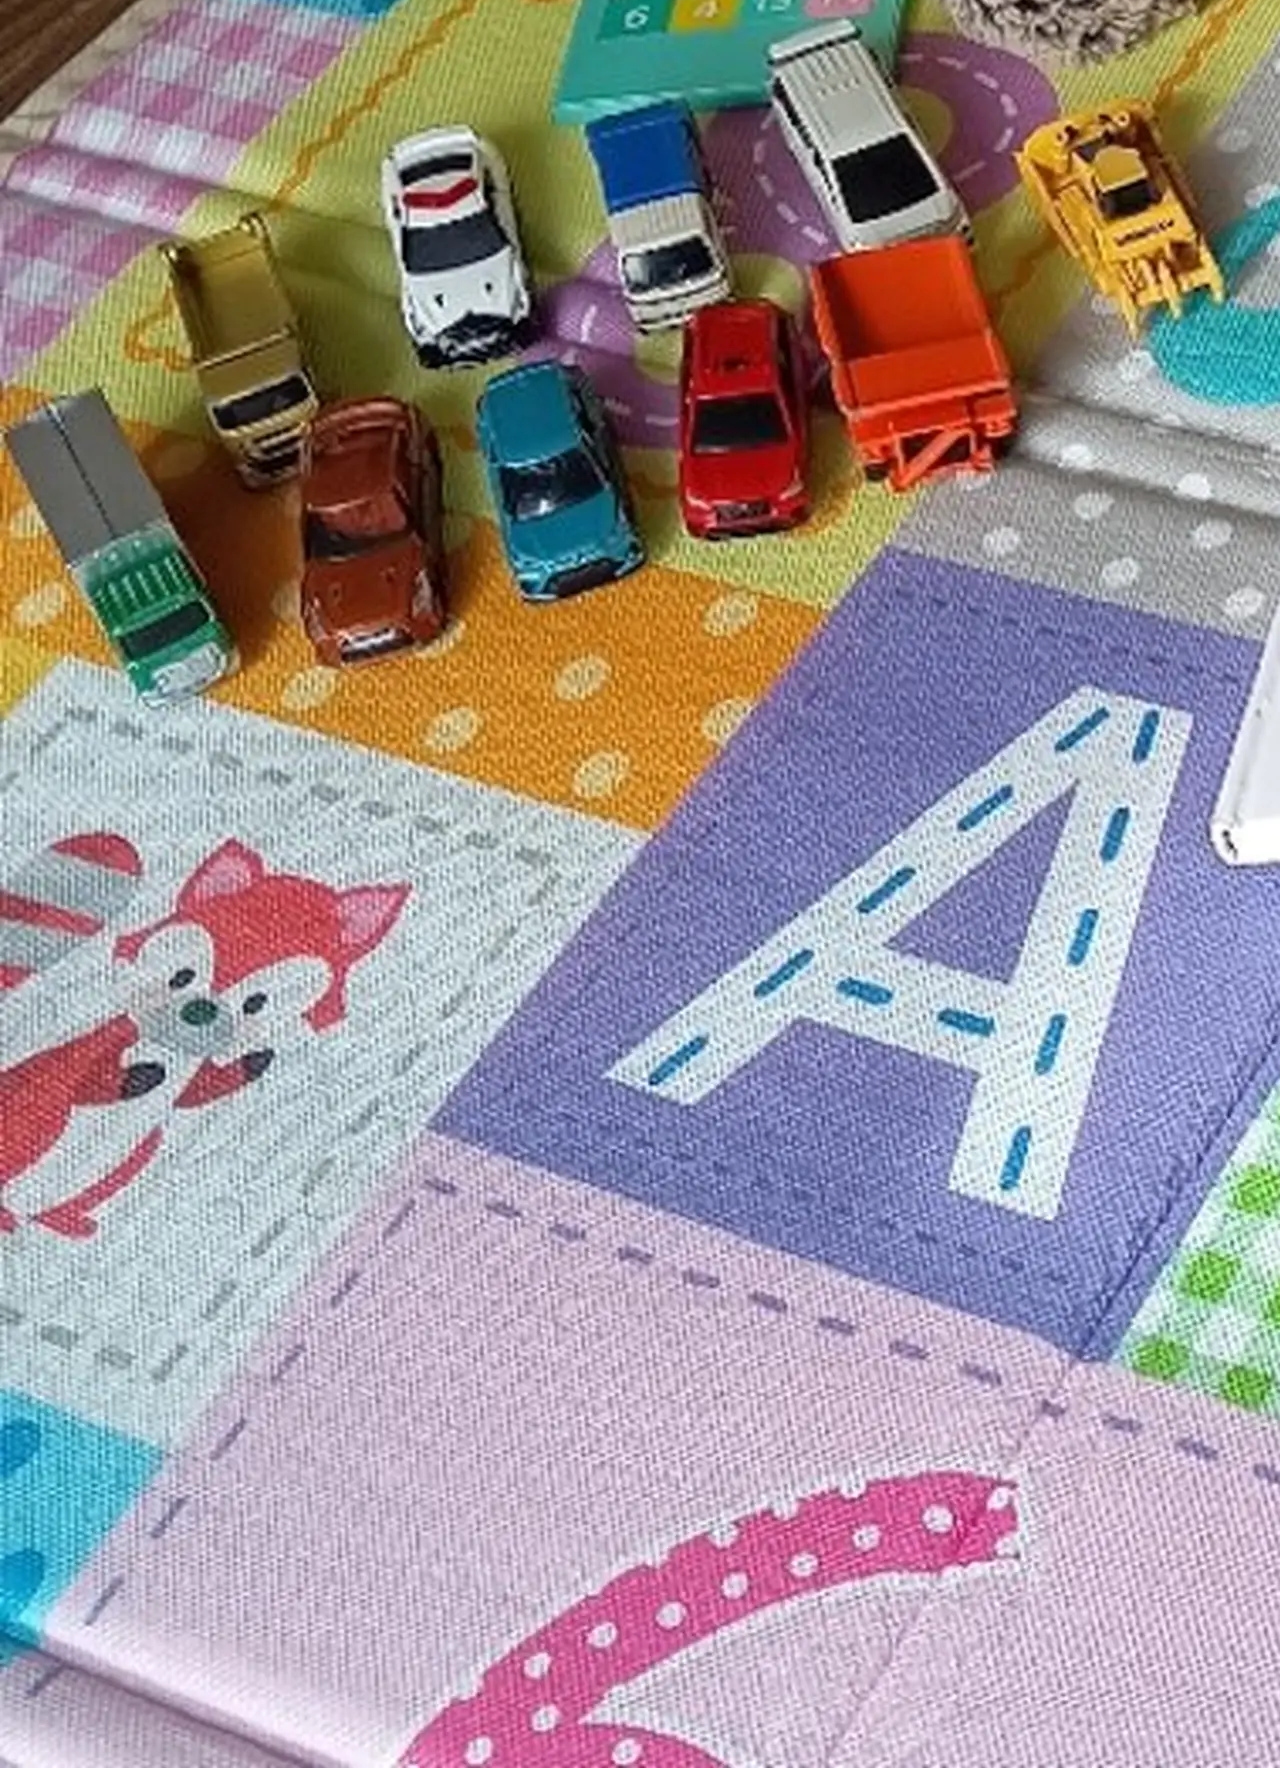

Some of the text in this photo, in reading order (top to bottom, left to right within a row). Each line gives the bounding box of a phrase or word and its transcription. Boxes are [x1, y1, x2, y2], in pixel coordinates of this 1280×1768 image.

[624, 5, 649, 28] 6
[694, 0, 720, 19] 4
[604, 686, 1192, 1219] A
